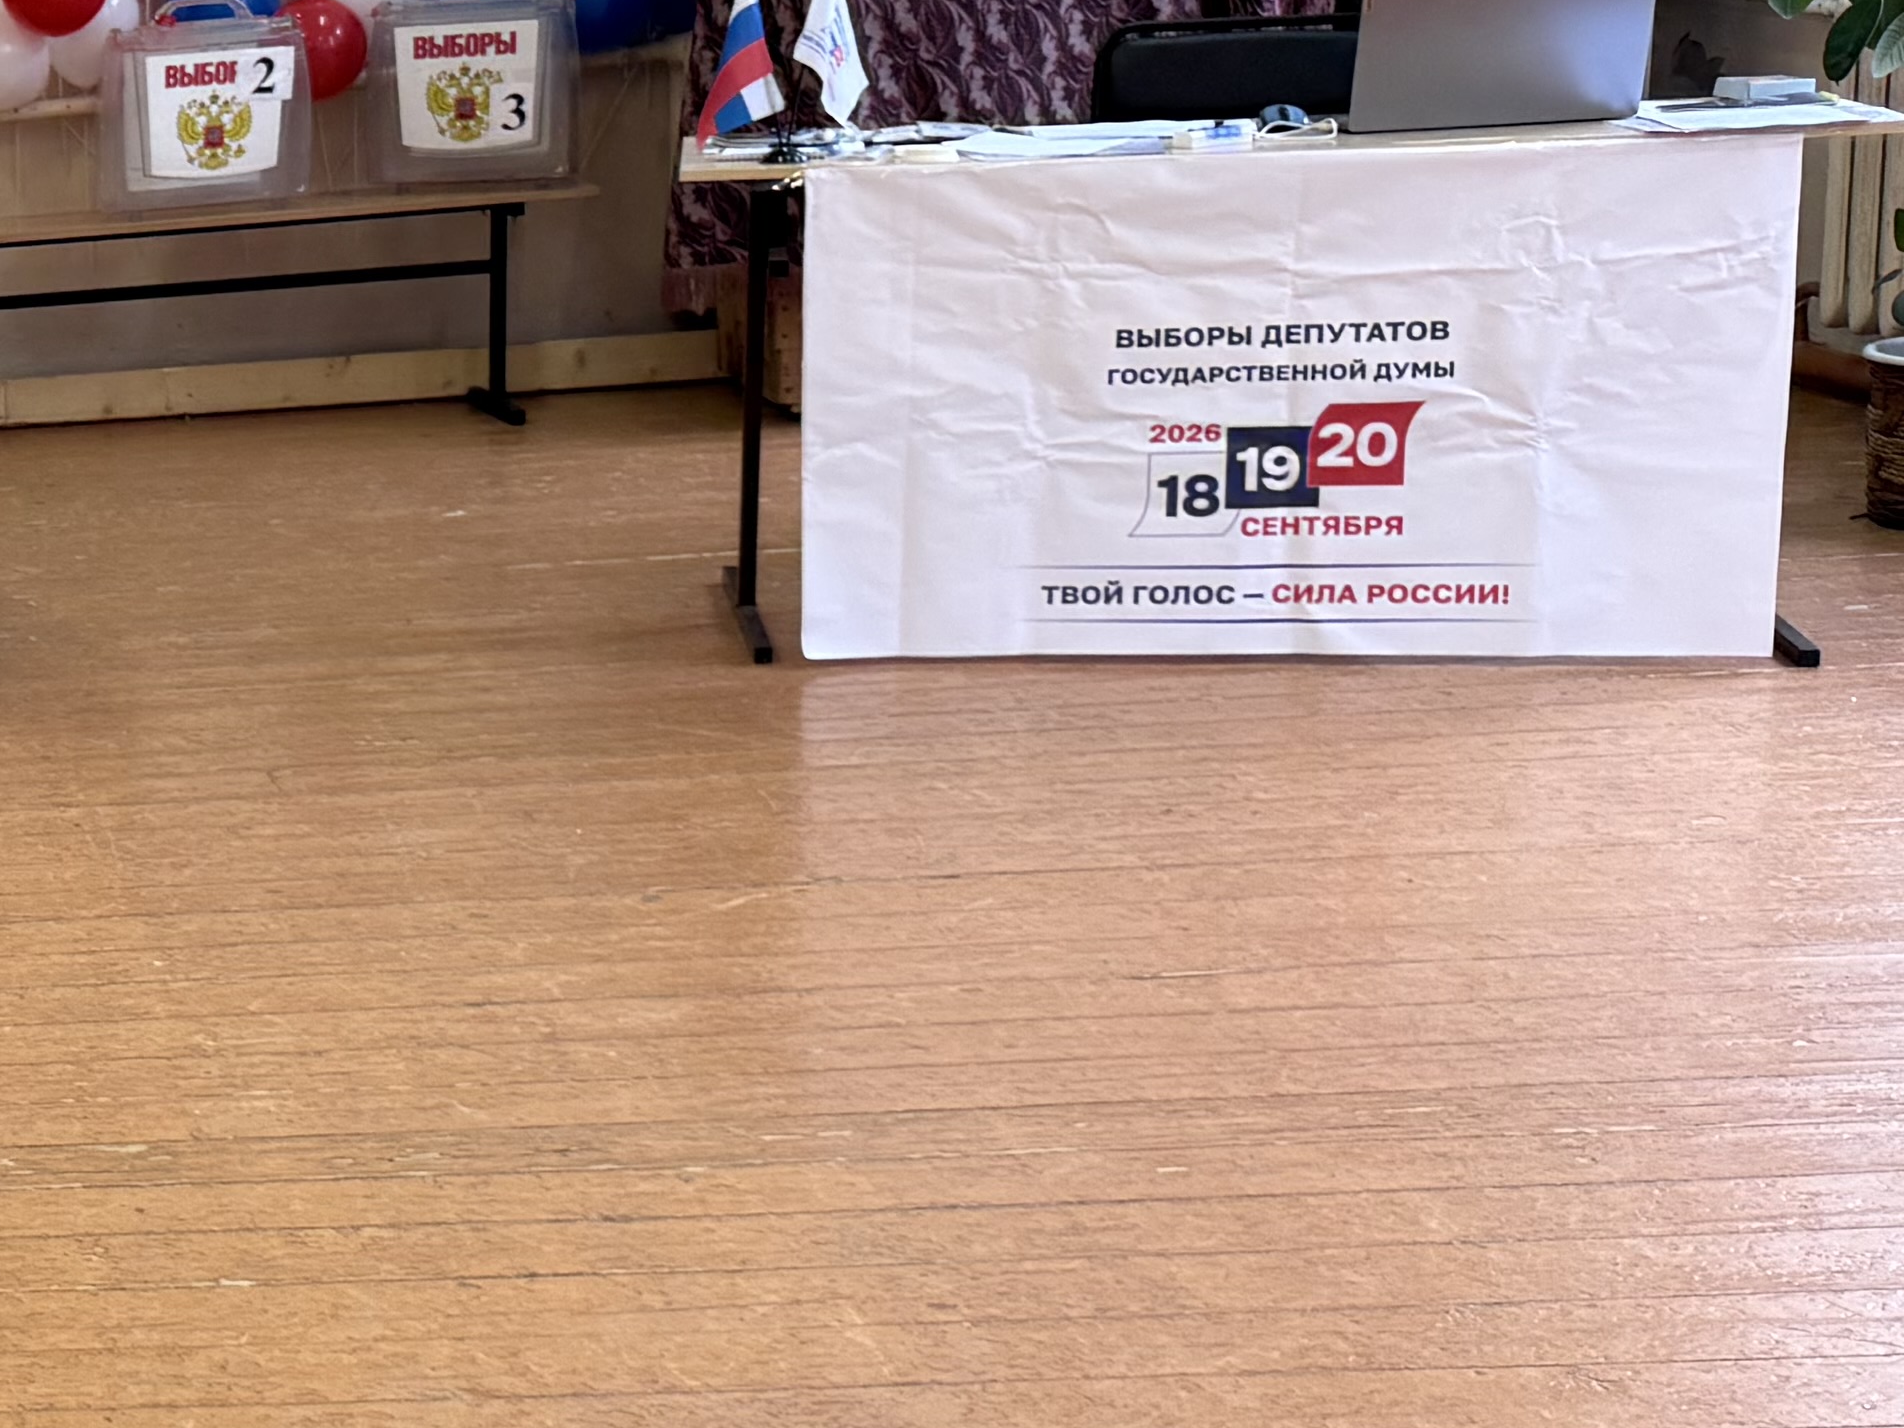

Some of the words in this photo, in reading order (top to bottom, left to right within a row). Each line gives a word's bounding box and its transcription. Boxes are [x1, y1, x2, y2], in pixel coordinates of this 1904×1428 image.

[413, 31, 518, 61] ВЫБОРЫ
[164, 60, 238, 89] ВЫБОР
[251, 57, 276, 95] 2
[500, 93, 527, 131] 3
[1114, 325, 1253, 349] ВЫБОРЫ
[1260, 320, 1450, 348] ДЕПУТАТОВ
[1107, 358, 1367, 387] ГОСУДАРСТВЕННОЙ
[1373, 360, 1456, 384] ДУМЫ
[1148, 422, 1222, 444] 2026
[1156, 473, 1221, 518] 18
[1235, 445, 1301, 493] 19
[1316, 420, 1399, 469] 20
[1240, 515, 1404, 538] СЕНТЯБРЯ
[1041, 580, 1125, 606] ТВОЙ
[1133, 584, 1236, 606] ГОЛОС
[1271, 584, 1358, 606] СИЛА
[1366, 583, 1511, 606] РОССИИ!
